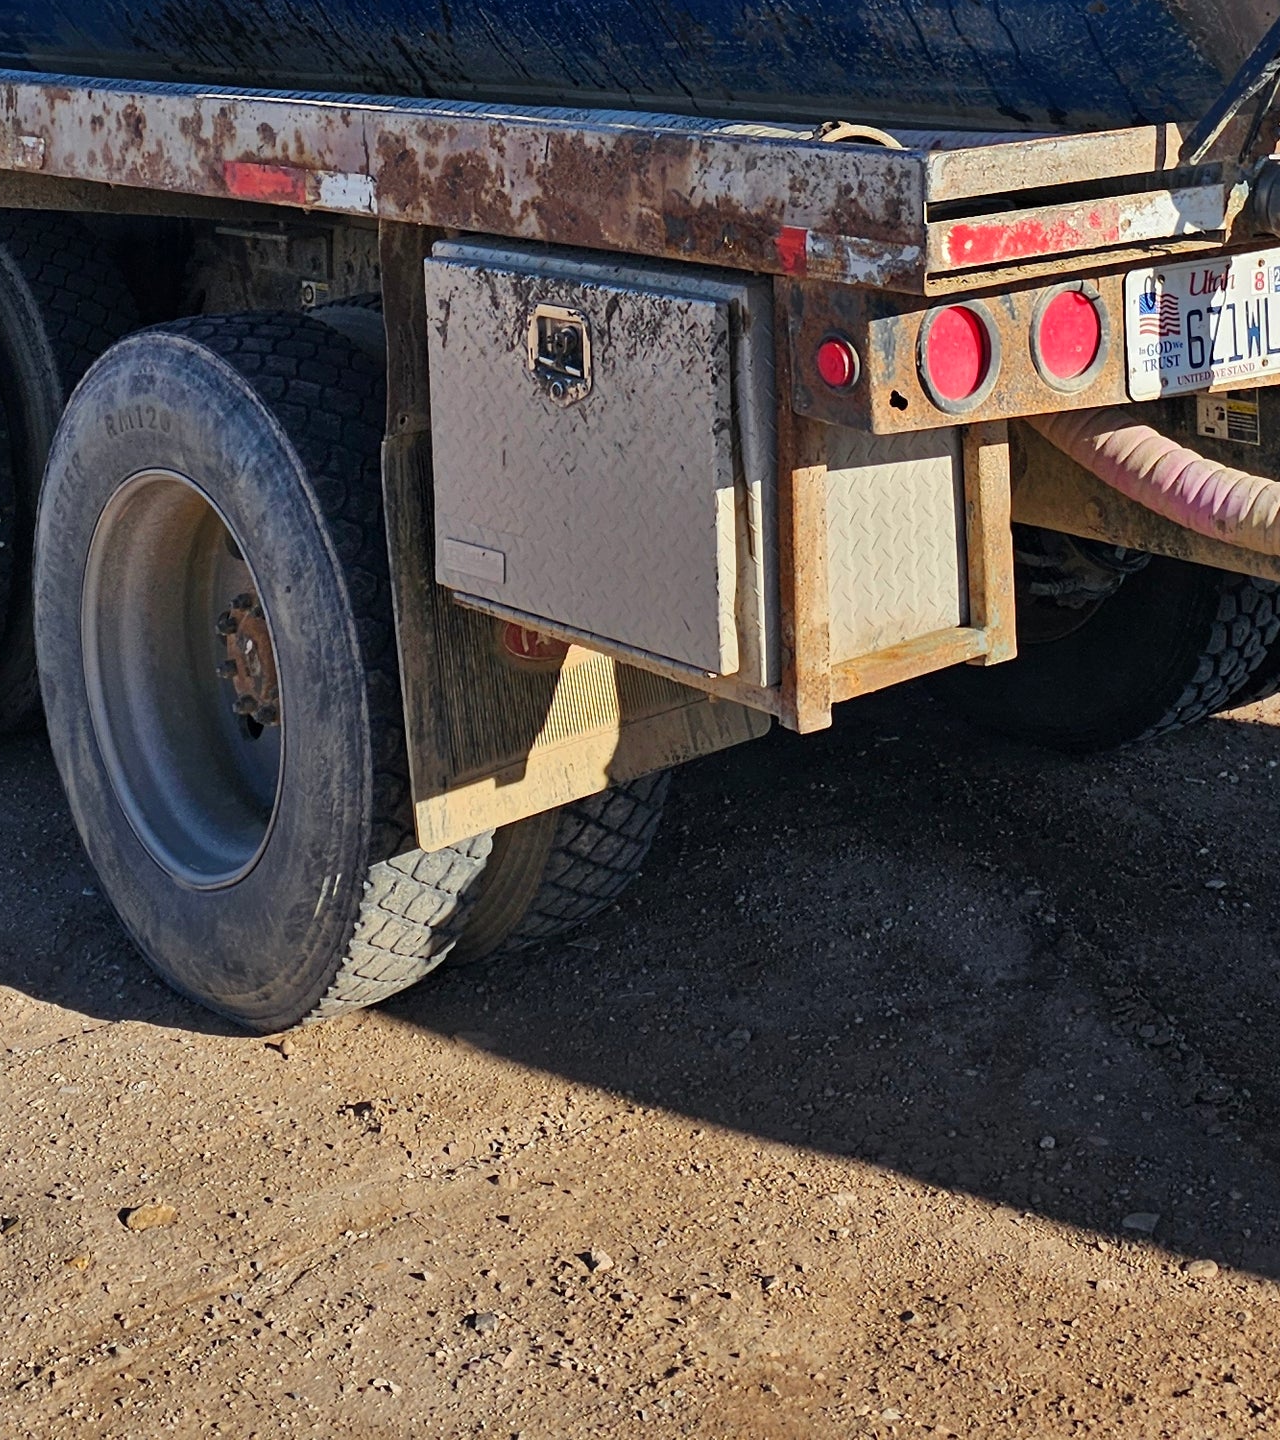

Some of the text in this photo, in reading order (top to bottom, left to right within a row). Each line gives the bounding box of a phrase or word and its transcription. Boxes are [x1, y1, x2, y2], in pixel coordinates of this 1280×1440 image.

[1189, 264, 1236, 297] Utah
[1254, 271, 1265, 291] 8
[1146, 340, 1172, 357] GOD
[1173, 340, 1184, 350] We
[1143, 353, 1181, 373] TRUST
[1177, 362, 1256, 386] UNITED WE STAND
